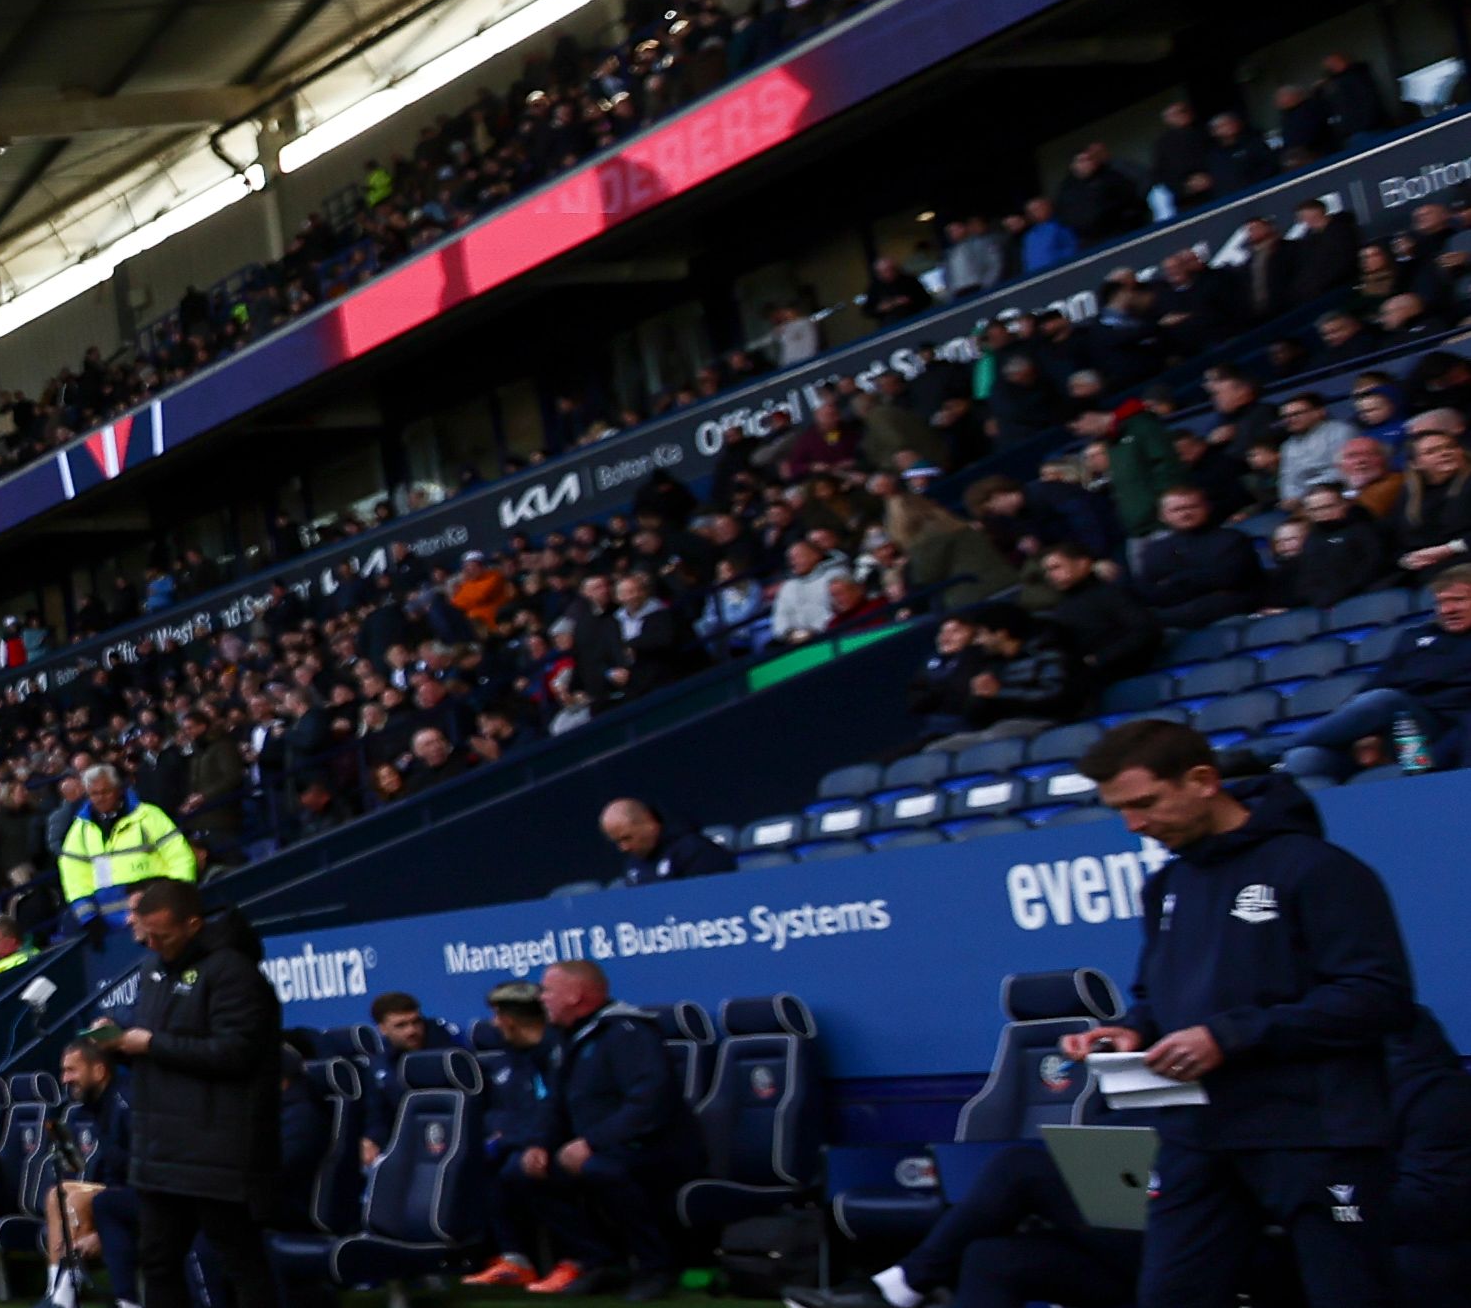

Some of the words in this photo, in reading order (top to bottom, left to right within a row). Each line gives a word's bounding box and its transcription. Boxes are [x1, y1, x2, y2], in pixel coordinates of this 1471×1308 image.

[258, 942, 367, 1004] ventura
[444, 930, 555, 976] Managed
[560, 927, 585, 960] IT
[589, 925, 614, 959] &
[616, 915, 747, 957] Business
[748, 898, 891, 952] Systems
